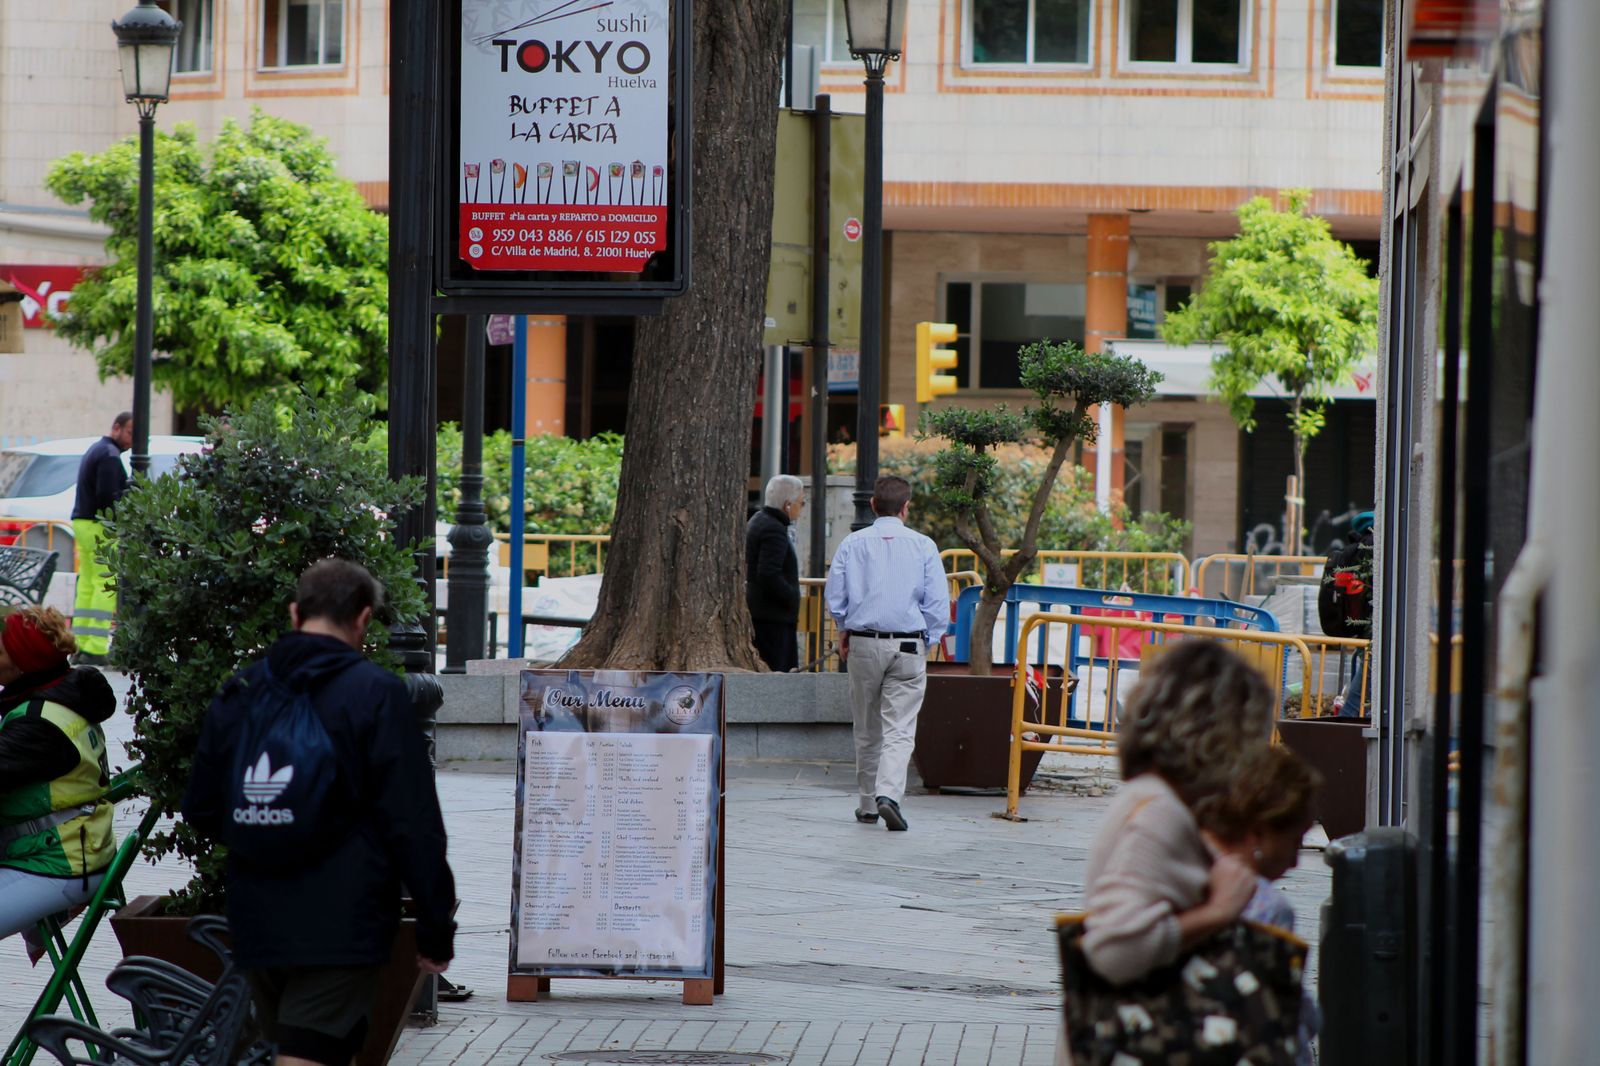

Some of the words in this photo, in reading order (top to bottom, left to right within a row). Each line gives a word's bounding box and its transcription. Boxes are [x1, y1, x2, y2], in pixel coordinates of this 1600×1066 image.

[597, 13, 647, 33] sushi
[492, 39, 651, 75] TOKYO
[608, 76, 657, 88] Huelva
[508, 95, 600, 117] BUFFET
[604, 96, 621, 118] A
[509, 122, 541, 143] LA
[549, 122, 618, 144] CARTA
[472, 212, 505, 220] BUFFET
[527, 213, 549, 221] carta
[551, 214, 557, 223] y
[560, 213, 598, 222] REPARTO
[608, 213, 657, 222] DOMICILIO
[492, 229, 515, 242] 959
[519, 229, 543, 242] 043
[548, 229, 573, 242] 886
[576, 230, 583, 242] /
[586, 230, 605, 243] 615
[610, 231, 629, 243] 129
[634, 232, 656, 244] 055
[491, 246, 502, 256] C/
[506, 246, 526, 256] Villa
[529, 246, 540, 257] de
[543, 246, 580, 257] Madrid,
[596, 247, 622, 257] 21001
[625, 248, 655, 258] Huelv
[546, 686, 583, 708] Our
[589, 689, 646, 709] Menu
[233, 804, 293, 824] adidas
[614, 902, 641, 910] Desserts
[548, 948, 567, 958] Follow
[592, 948, 622, 959] Facebook
[625, 949, 637, 959] and
